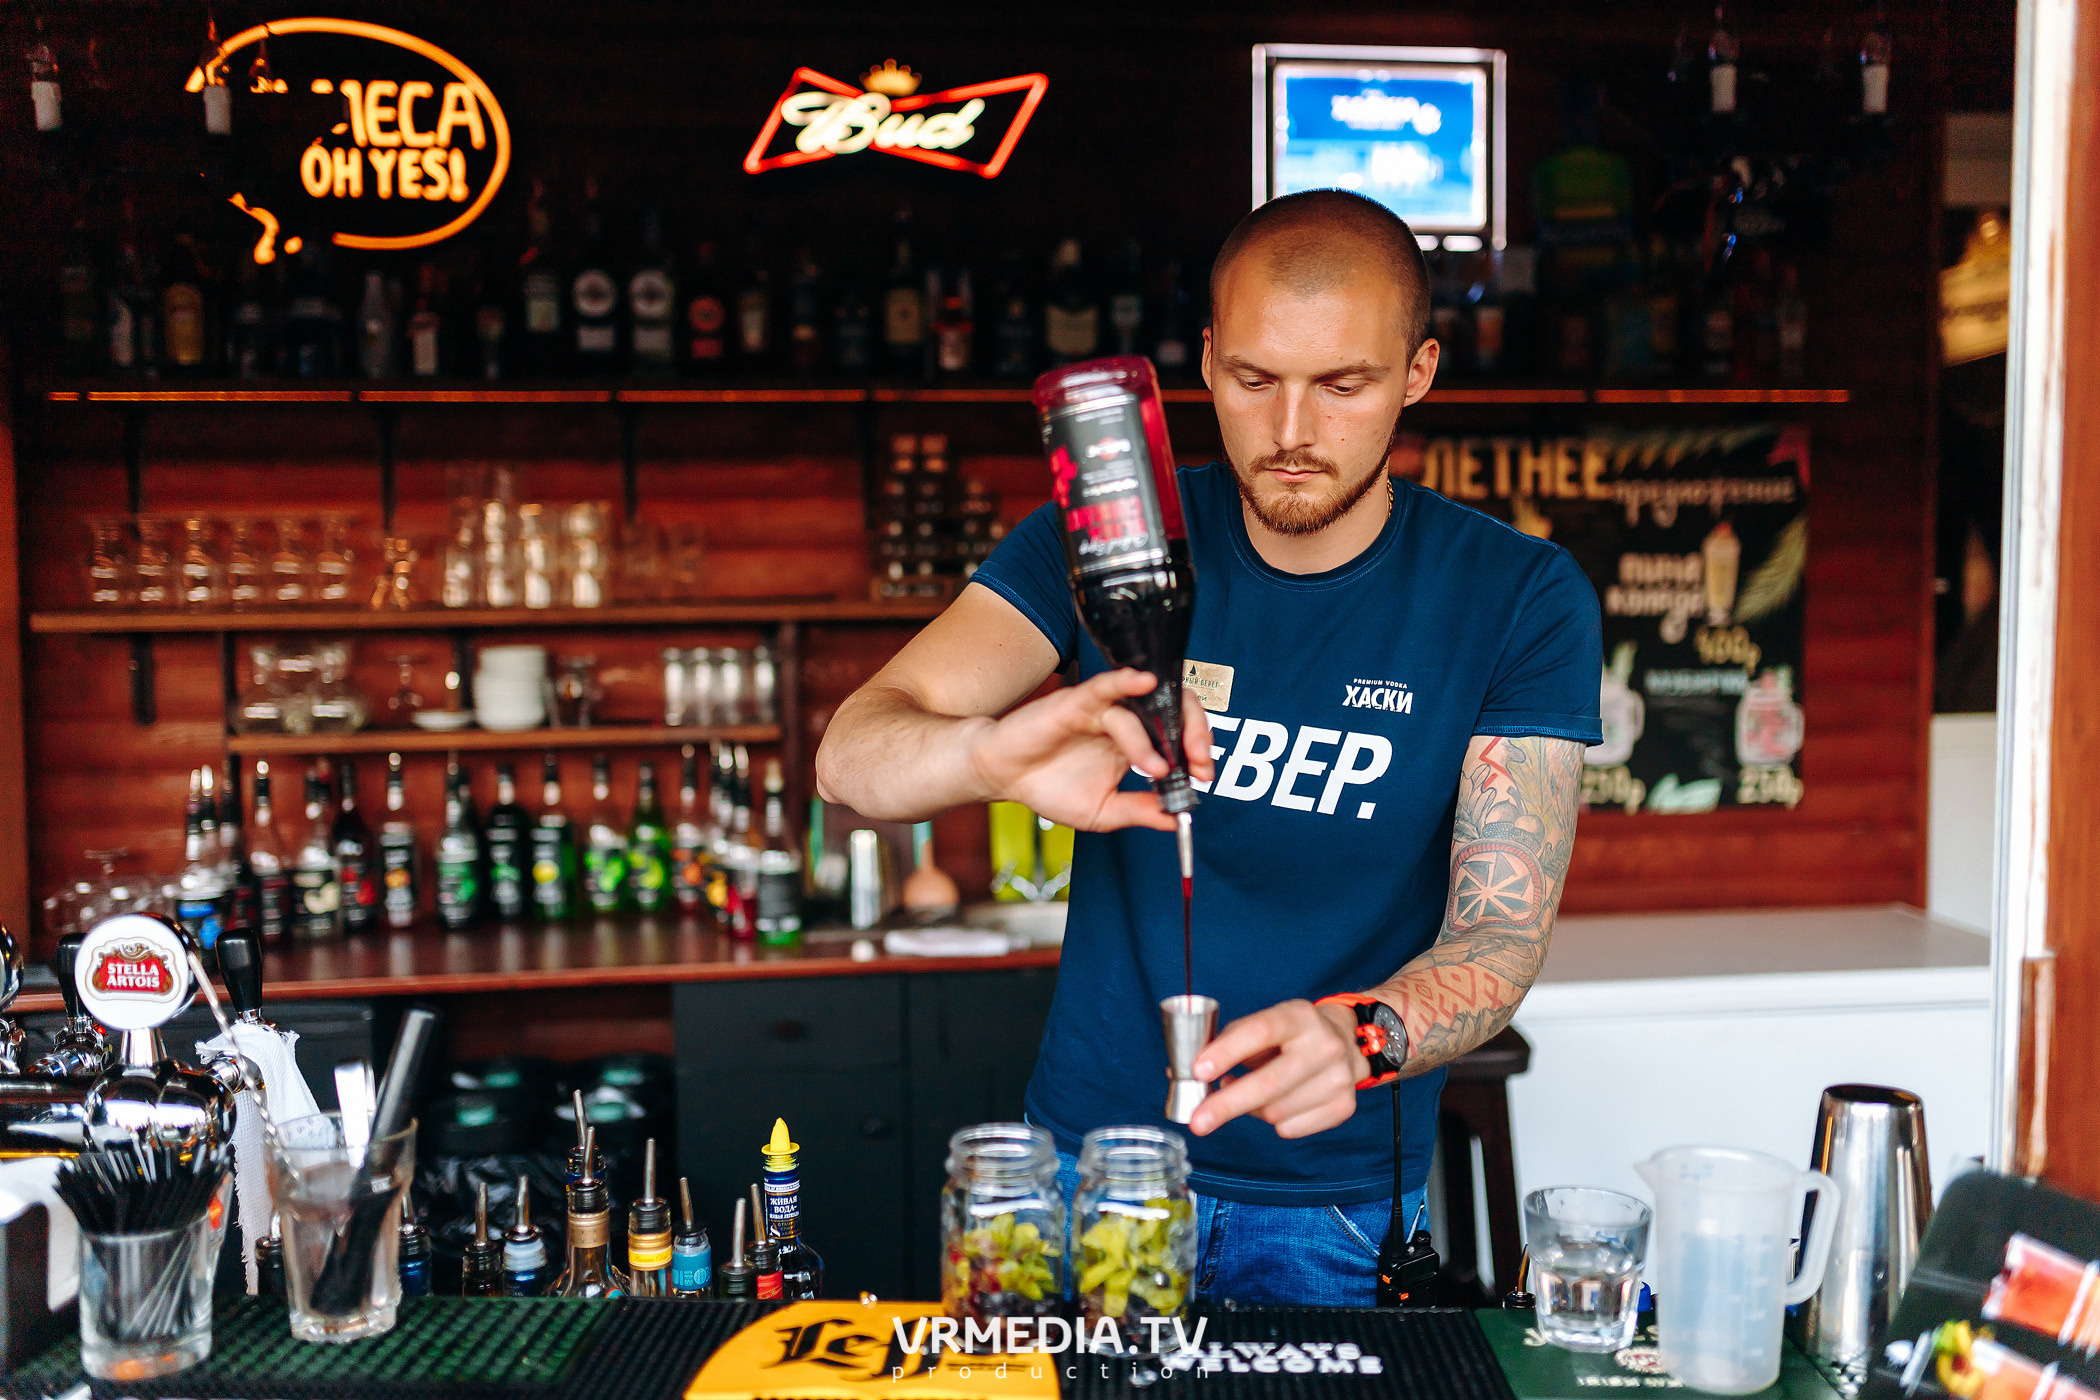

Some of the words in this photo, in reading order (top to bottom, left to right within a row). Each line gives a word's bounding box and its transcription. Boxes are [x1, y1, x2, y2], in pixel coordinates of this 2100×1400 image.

[780, 91, 985, 154] Bud
[300, 145, 364, 199] OH
[367, 146, 470, 203] YES!
[1421, 438, 1614, 500] ЛЕТНЕЕ
[1200, 679, 1219, 689] БЕРЕГ
[1353, 678, 1384, 686] PREMIUM
[1385, 680, 1408, 690] VODKA
[1341, 684, 1414, 715] ХАСКИ
[1130, 711, 1393, 820] ЕВЕР.
[107, 963, 160, 976] STELLA
[106, 975, 160, 988] ARTOIS
[769, 1195, 798, 1206] ЖИВАЯ
[1160, 1355, 1384, 1374] WELCOME
